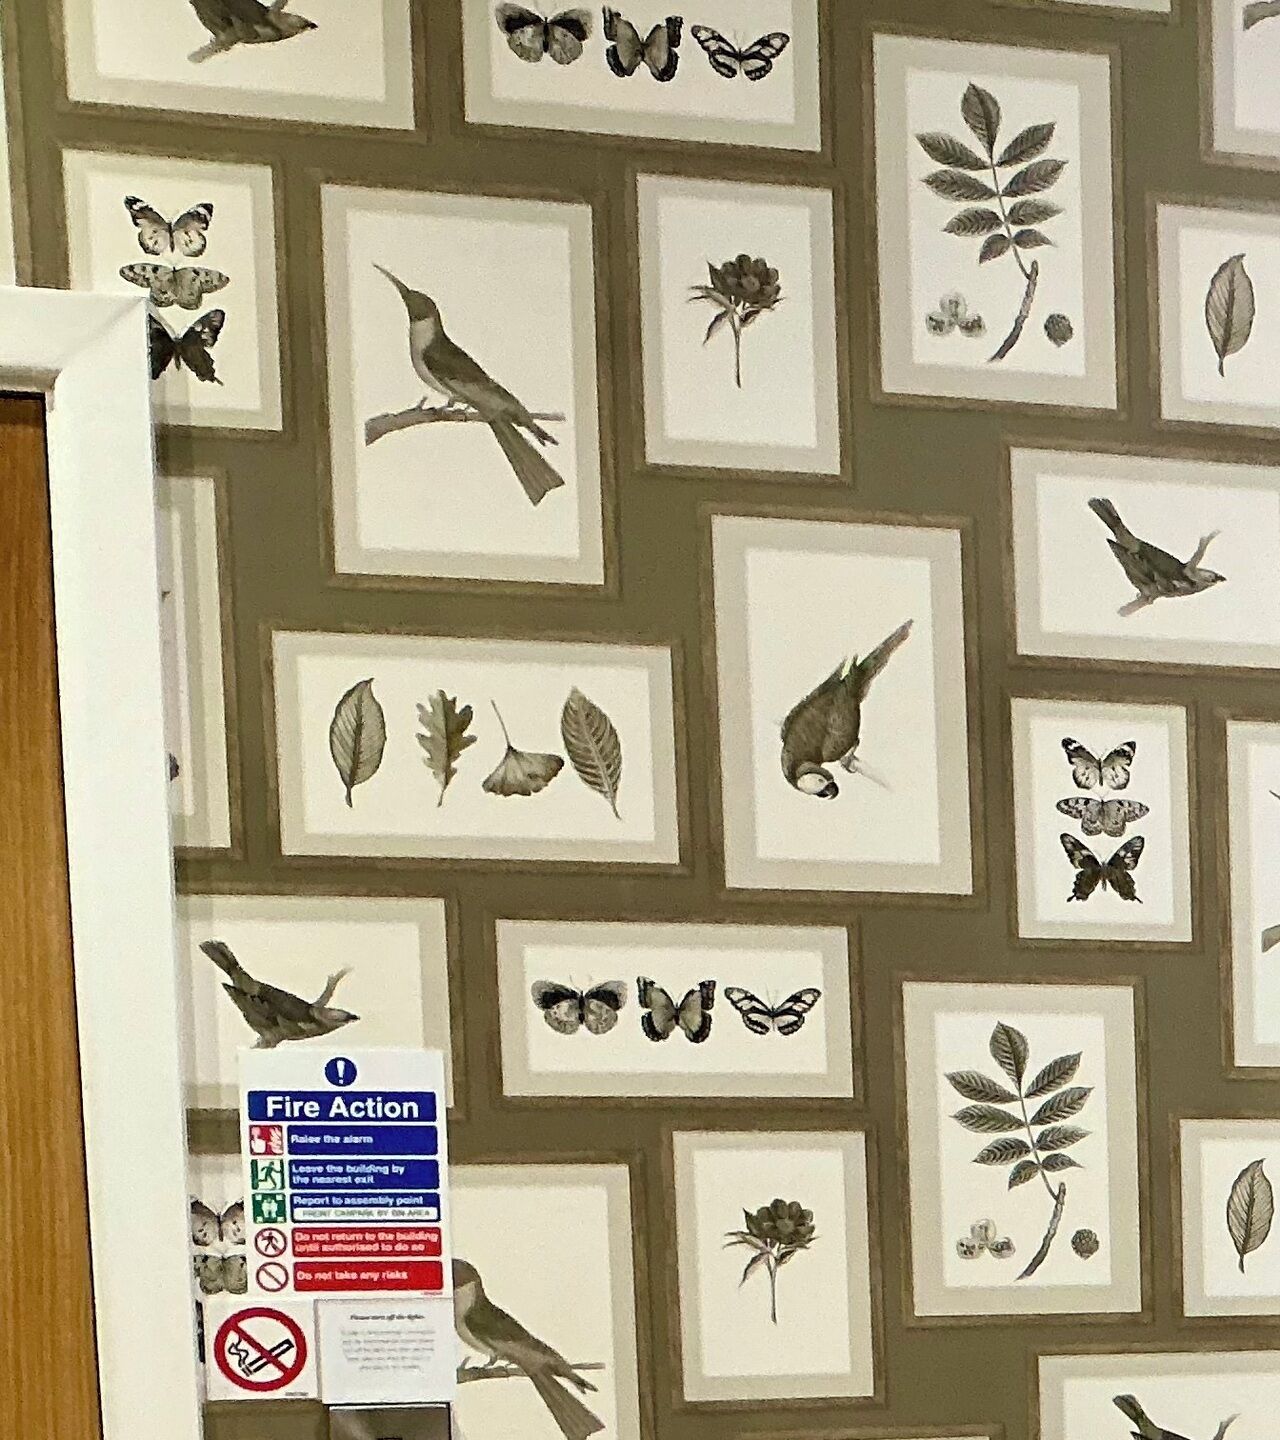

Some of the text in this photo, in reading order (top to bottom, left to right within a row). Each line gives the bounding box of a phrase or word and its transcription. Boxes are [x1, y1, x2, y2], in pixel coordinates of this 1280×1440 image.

[266, 1096, 419, 1118] Fire Action
[291, 1135, 373, 1144] Raise the alarm
[292, 1164, 405, 1175] Leave the building by
[293, 1175, 375, 1184] the nearest exit
[294, 1196, 423, 1206] Report to assembly point
[295, 1231, 439, 1242] Do not return to the building
[296, 1271, 312, 1280] Do
[315, 1271, 332, 1280] not
[335, 1271, 358, 1280] take
[360, 1272, 380, 1281] any
